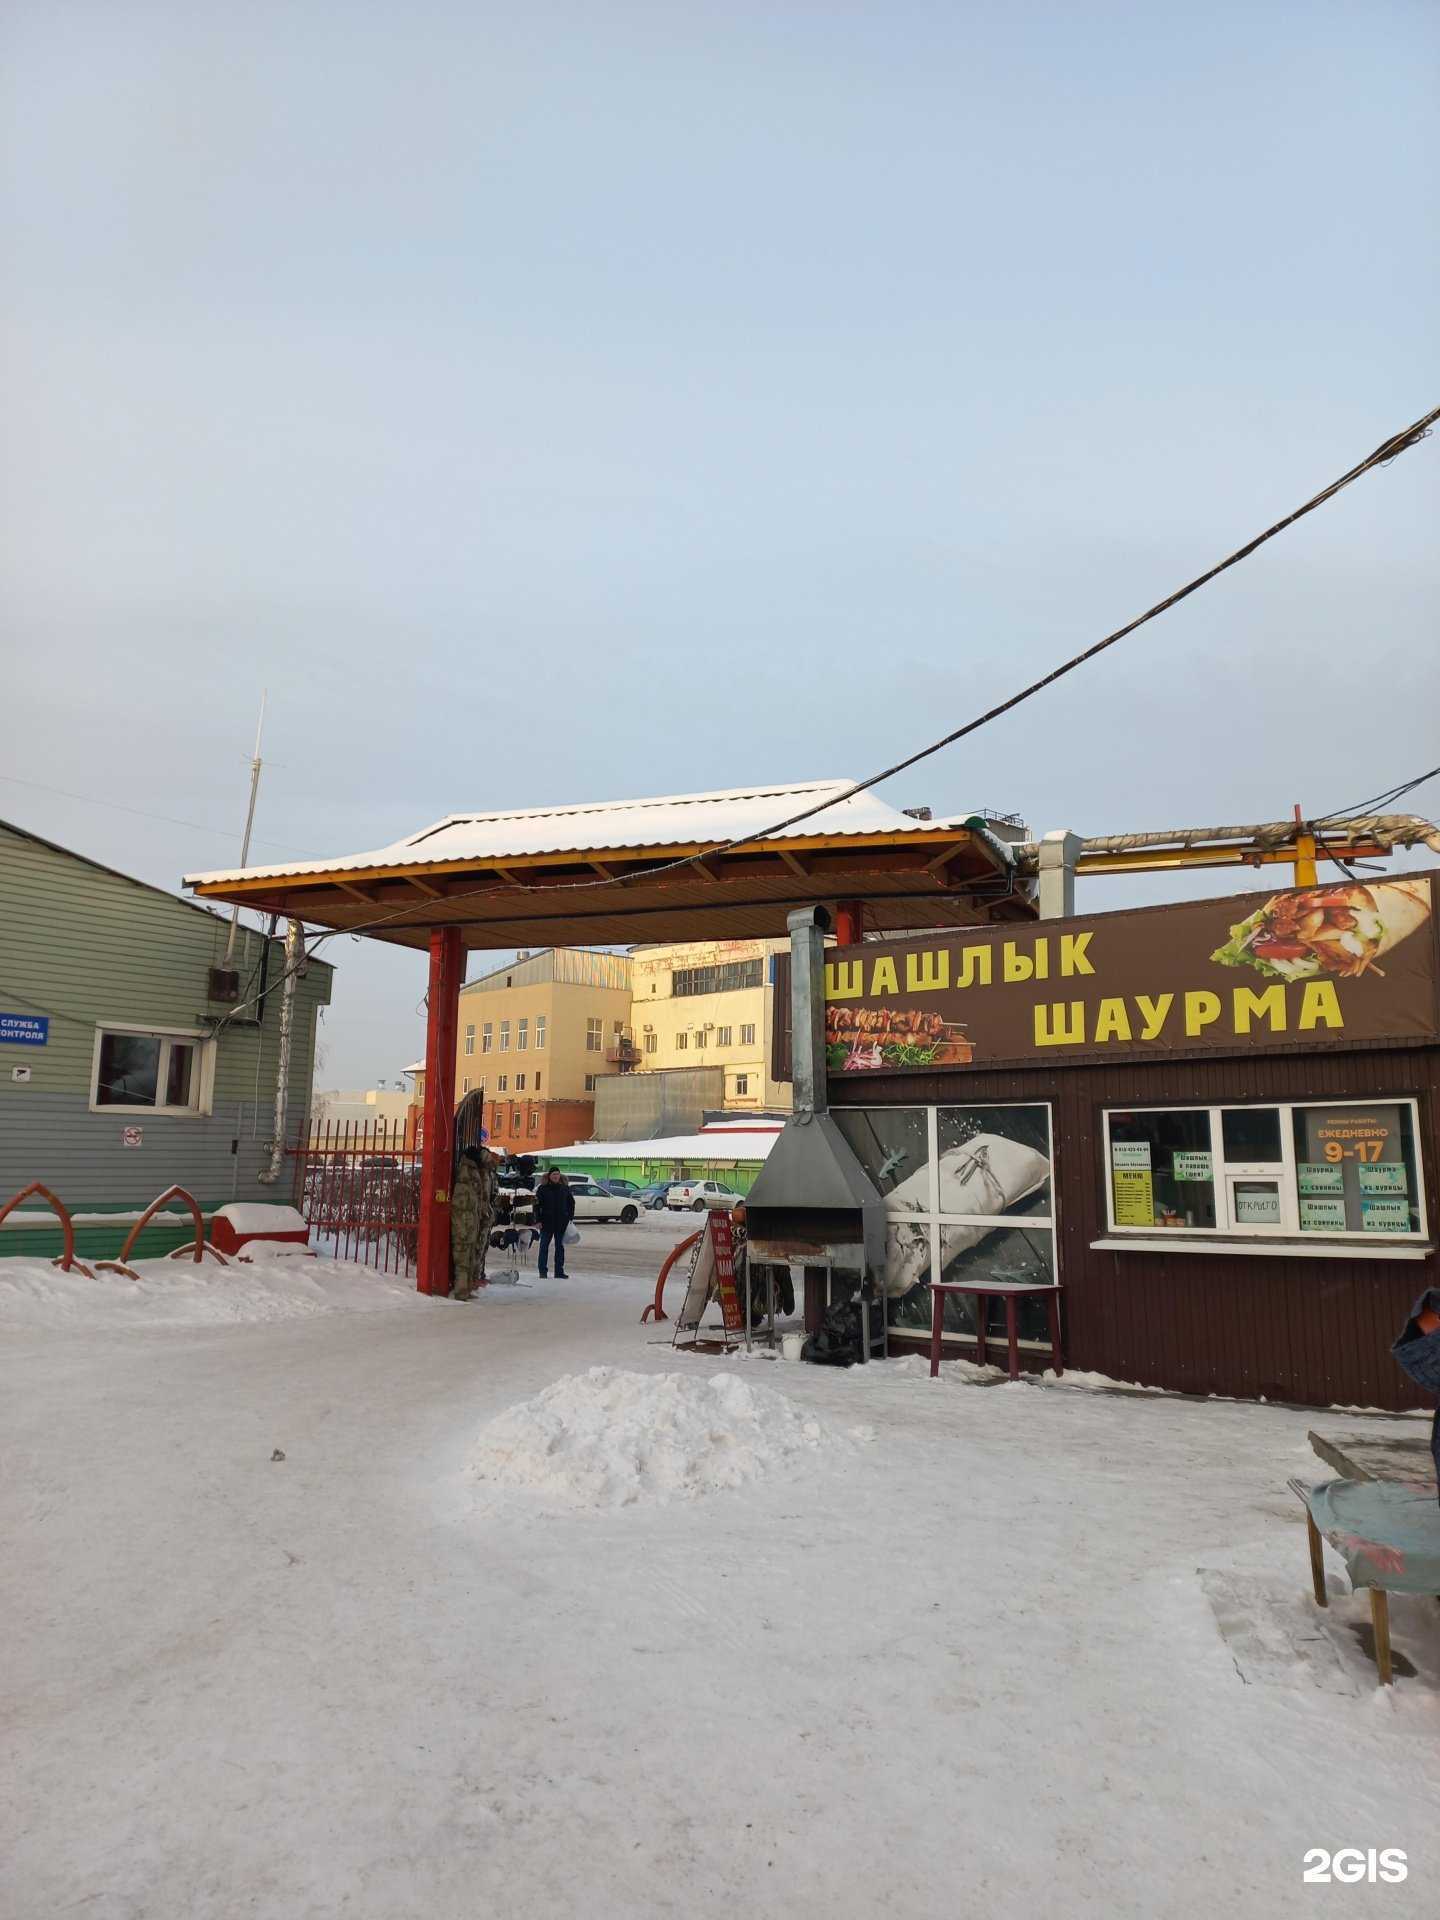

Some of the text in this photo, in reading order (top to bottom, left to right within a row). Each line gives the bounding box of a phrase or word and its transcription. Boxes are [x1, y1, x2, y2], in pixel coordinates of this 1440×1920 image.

[825, 932, 1096, 1000] ШАШЛЫК
[1034, 981, 1344, 1047] ШАУРМА
[1, 1020, 39, 1029] СЛУЖБА
[0, 1030, 44, 1040] ОНТРОЛЯ
[1318, 1128, 1389, 1139] ЕЖЕДНЕВНО
[1324, 1140, 1384, 1163] 9-17
[1238, 1200, 1278, 1211] ОТКРЫТО
